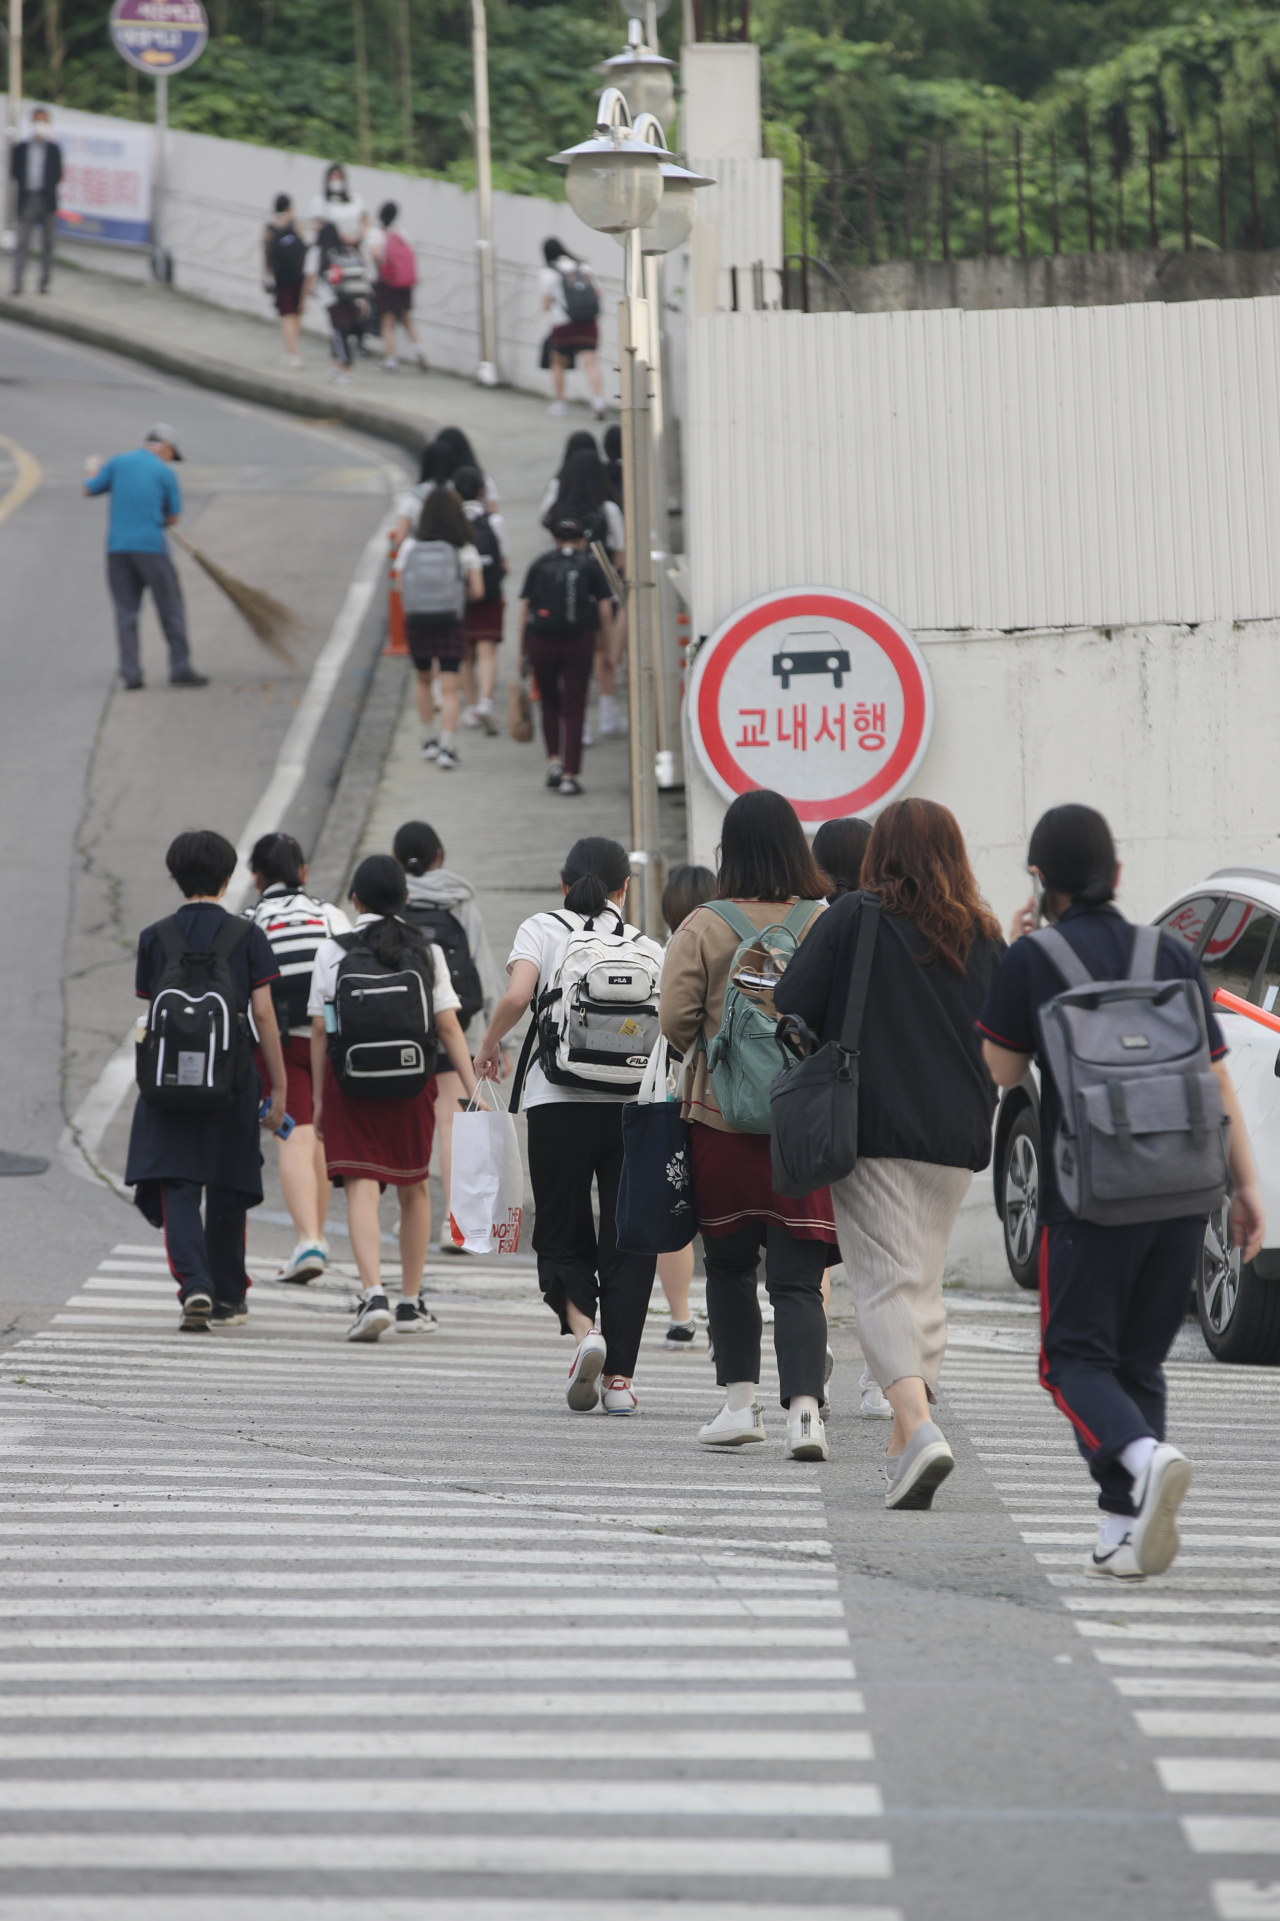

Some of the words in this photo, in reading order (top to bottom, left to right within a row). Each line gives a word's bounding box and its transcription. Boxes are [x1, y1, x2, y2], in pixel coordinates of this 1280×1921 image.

[735, 702, 887, 752] 교내서행
[629, 1057, 648, 1065] FILA
[507, 1207, 519, 1223] THE
